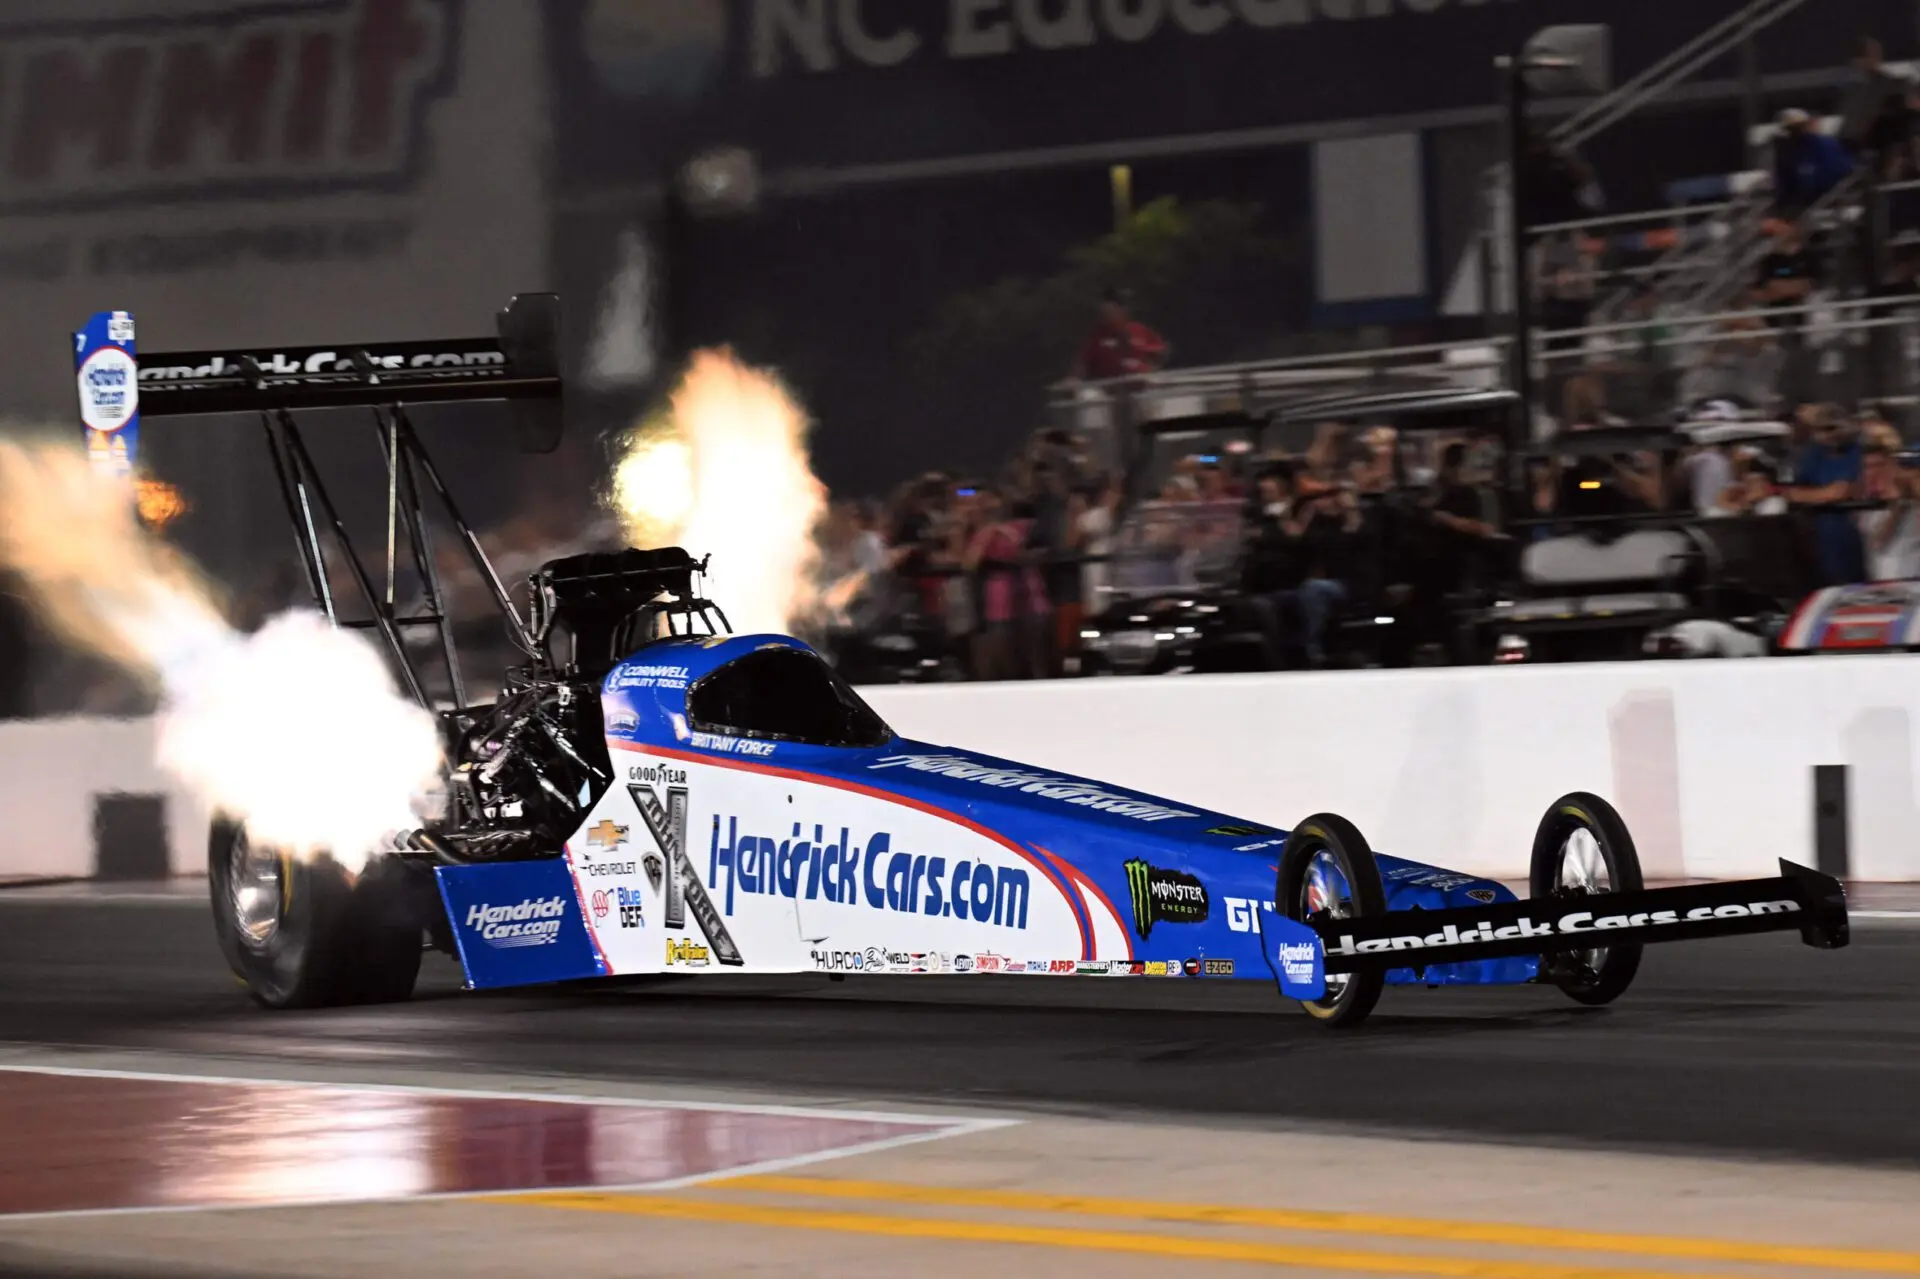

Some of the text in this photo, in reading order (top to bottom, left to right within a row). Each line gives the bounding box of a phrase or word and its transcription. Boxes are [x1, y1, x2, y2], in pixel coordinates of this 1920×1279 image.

[624, 665, 690, 679] CORNWELL
[619, 677, 686, 689] QUALITY TOOLS
[691, 732, 777, 756] BRITTANY FORCE
[588, 861, 636, 876] CHEVROLET
[617, 886, 641, 906] Blue
[1151, 879, 1204, 903] MONSTER
[465, 896, 567, 931] Hendrick
[620, 906, 642, 928] DEF
[1161, 903, 1198, 914] ENERGY
[483, 920, 561, 940] Cars.com
[815, 951, 864, 970] HURCO
[1049, 960, 1075, 972] ARP
